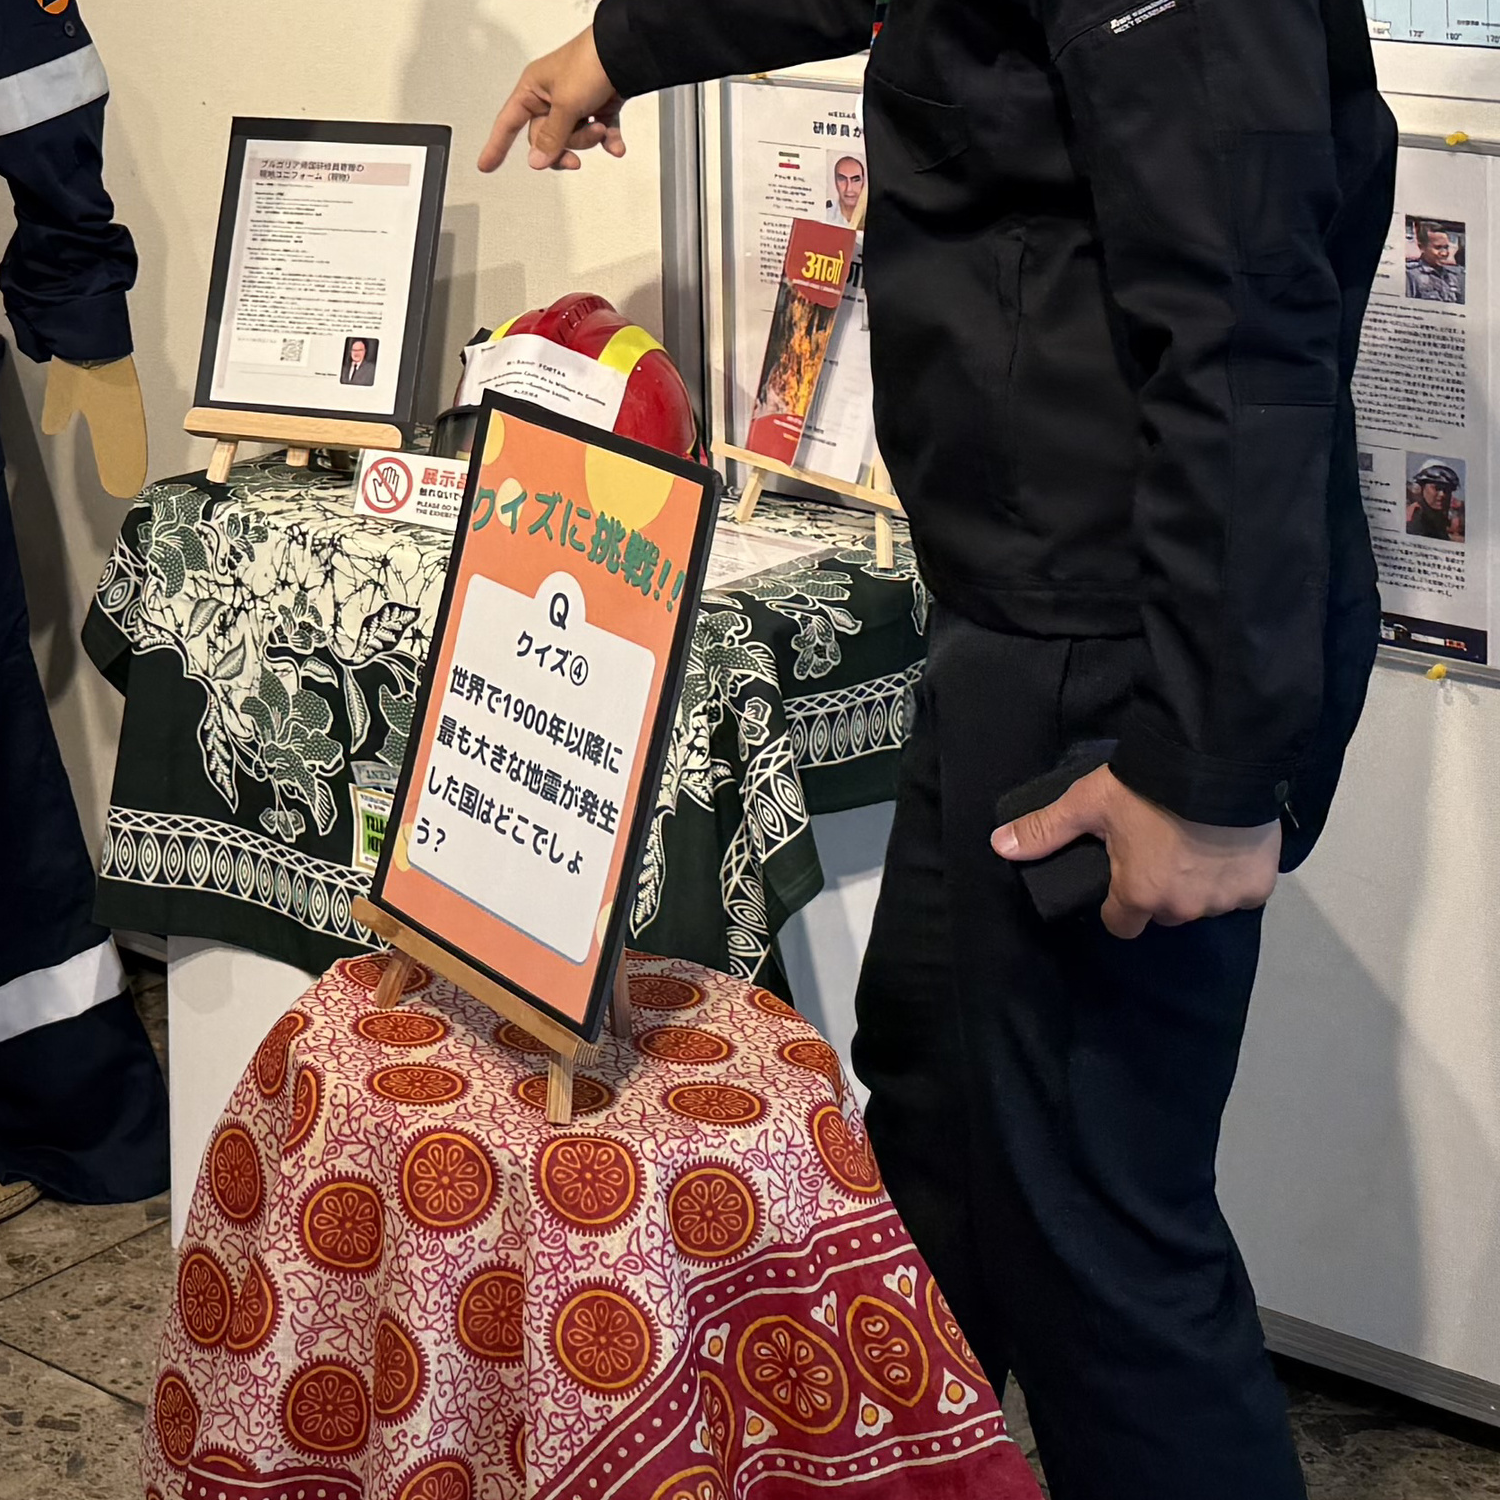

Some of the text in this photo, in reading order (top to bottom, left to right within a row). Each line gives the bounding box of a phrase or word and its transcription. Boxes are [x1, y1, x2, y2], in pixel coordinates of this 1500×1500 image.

[549, 592, 570, 630] Q
[450, 665, 623, 774] 世界で1900年以降に
[428, 766, 583, 874] した国はどこでしょ
[437, 715, 619, 835] 最も大きな地震が発生
